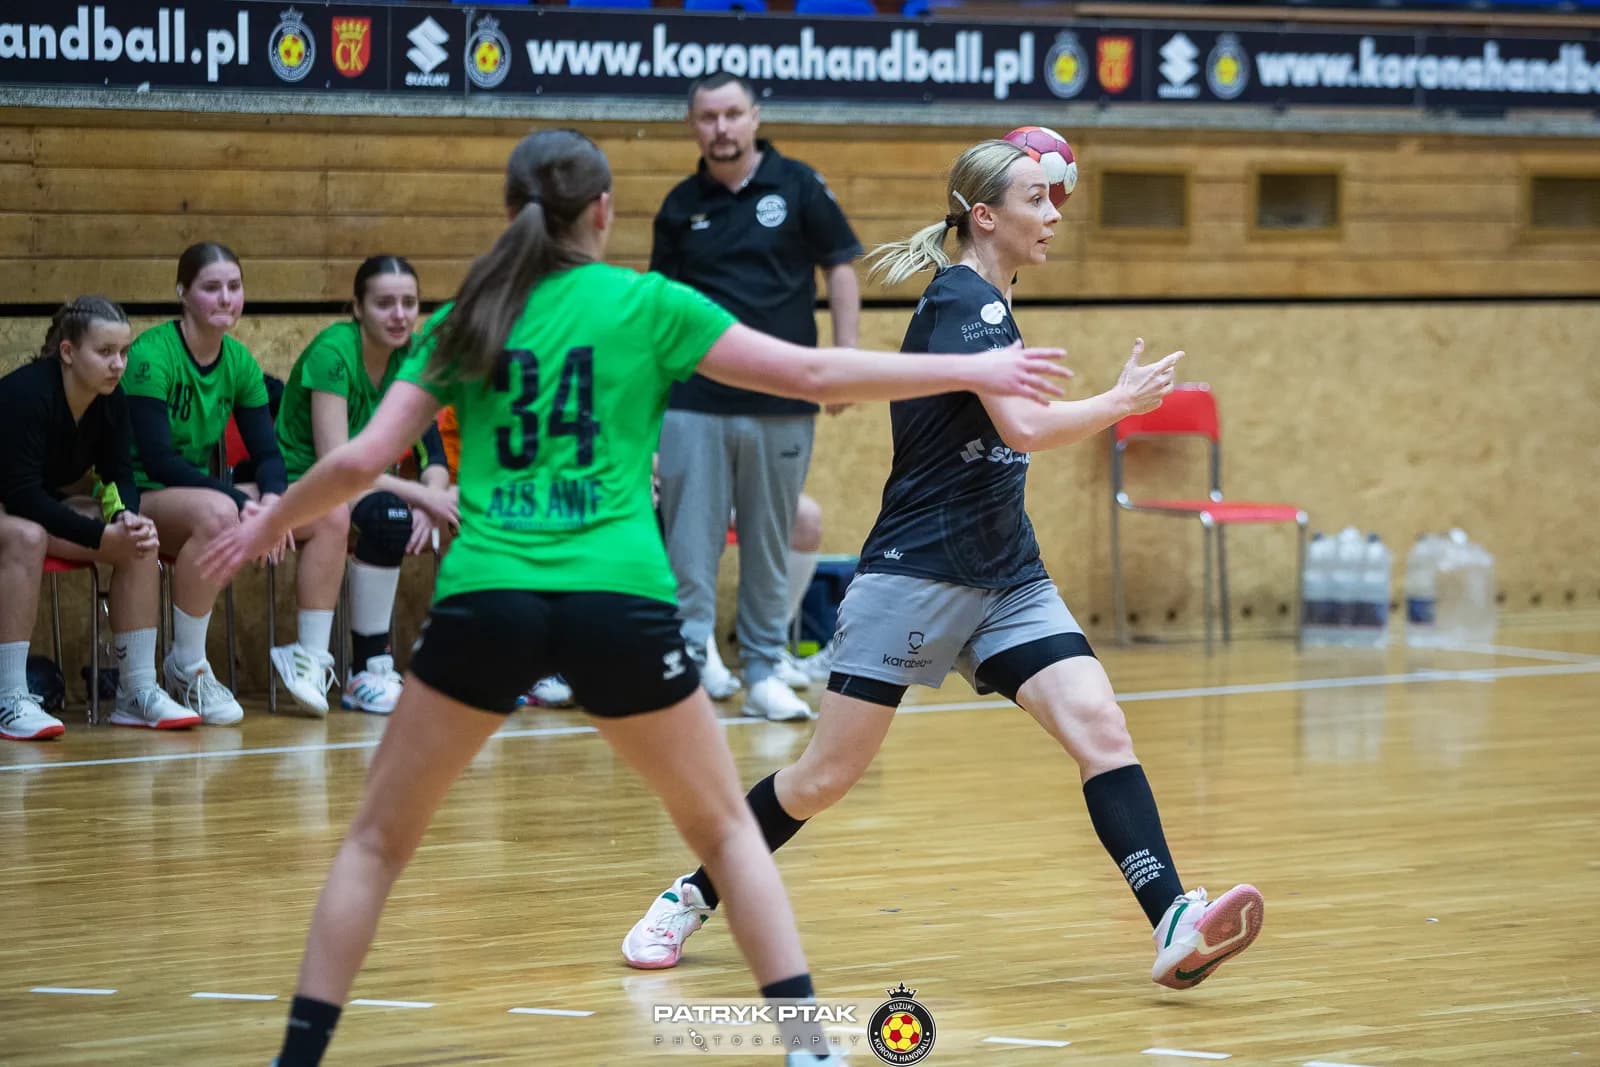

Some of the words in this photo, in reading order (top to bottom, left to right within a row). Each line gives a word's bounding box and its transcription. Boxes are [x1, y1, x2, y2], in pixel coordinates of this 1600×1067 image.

[405, 72, 450, 86] SUZUKI
[526, 24, 1035, 99] www.koronahandball.pl
[961, 321, 982, 334] Sun
[963, 327, 1007, 342] Horizon
[167, 383, 192, 421] 48
[493, 346, 602, 470] 34
[545, 479, 603, 518] AWF
